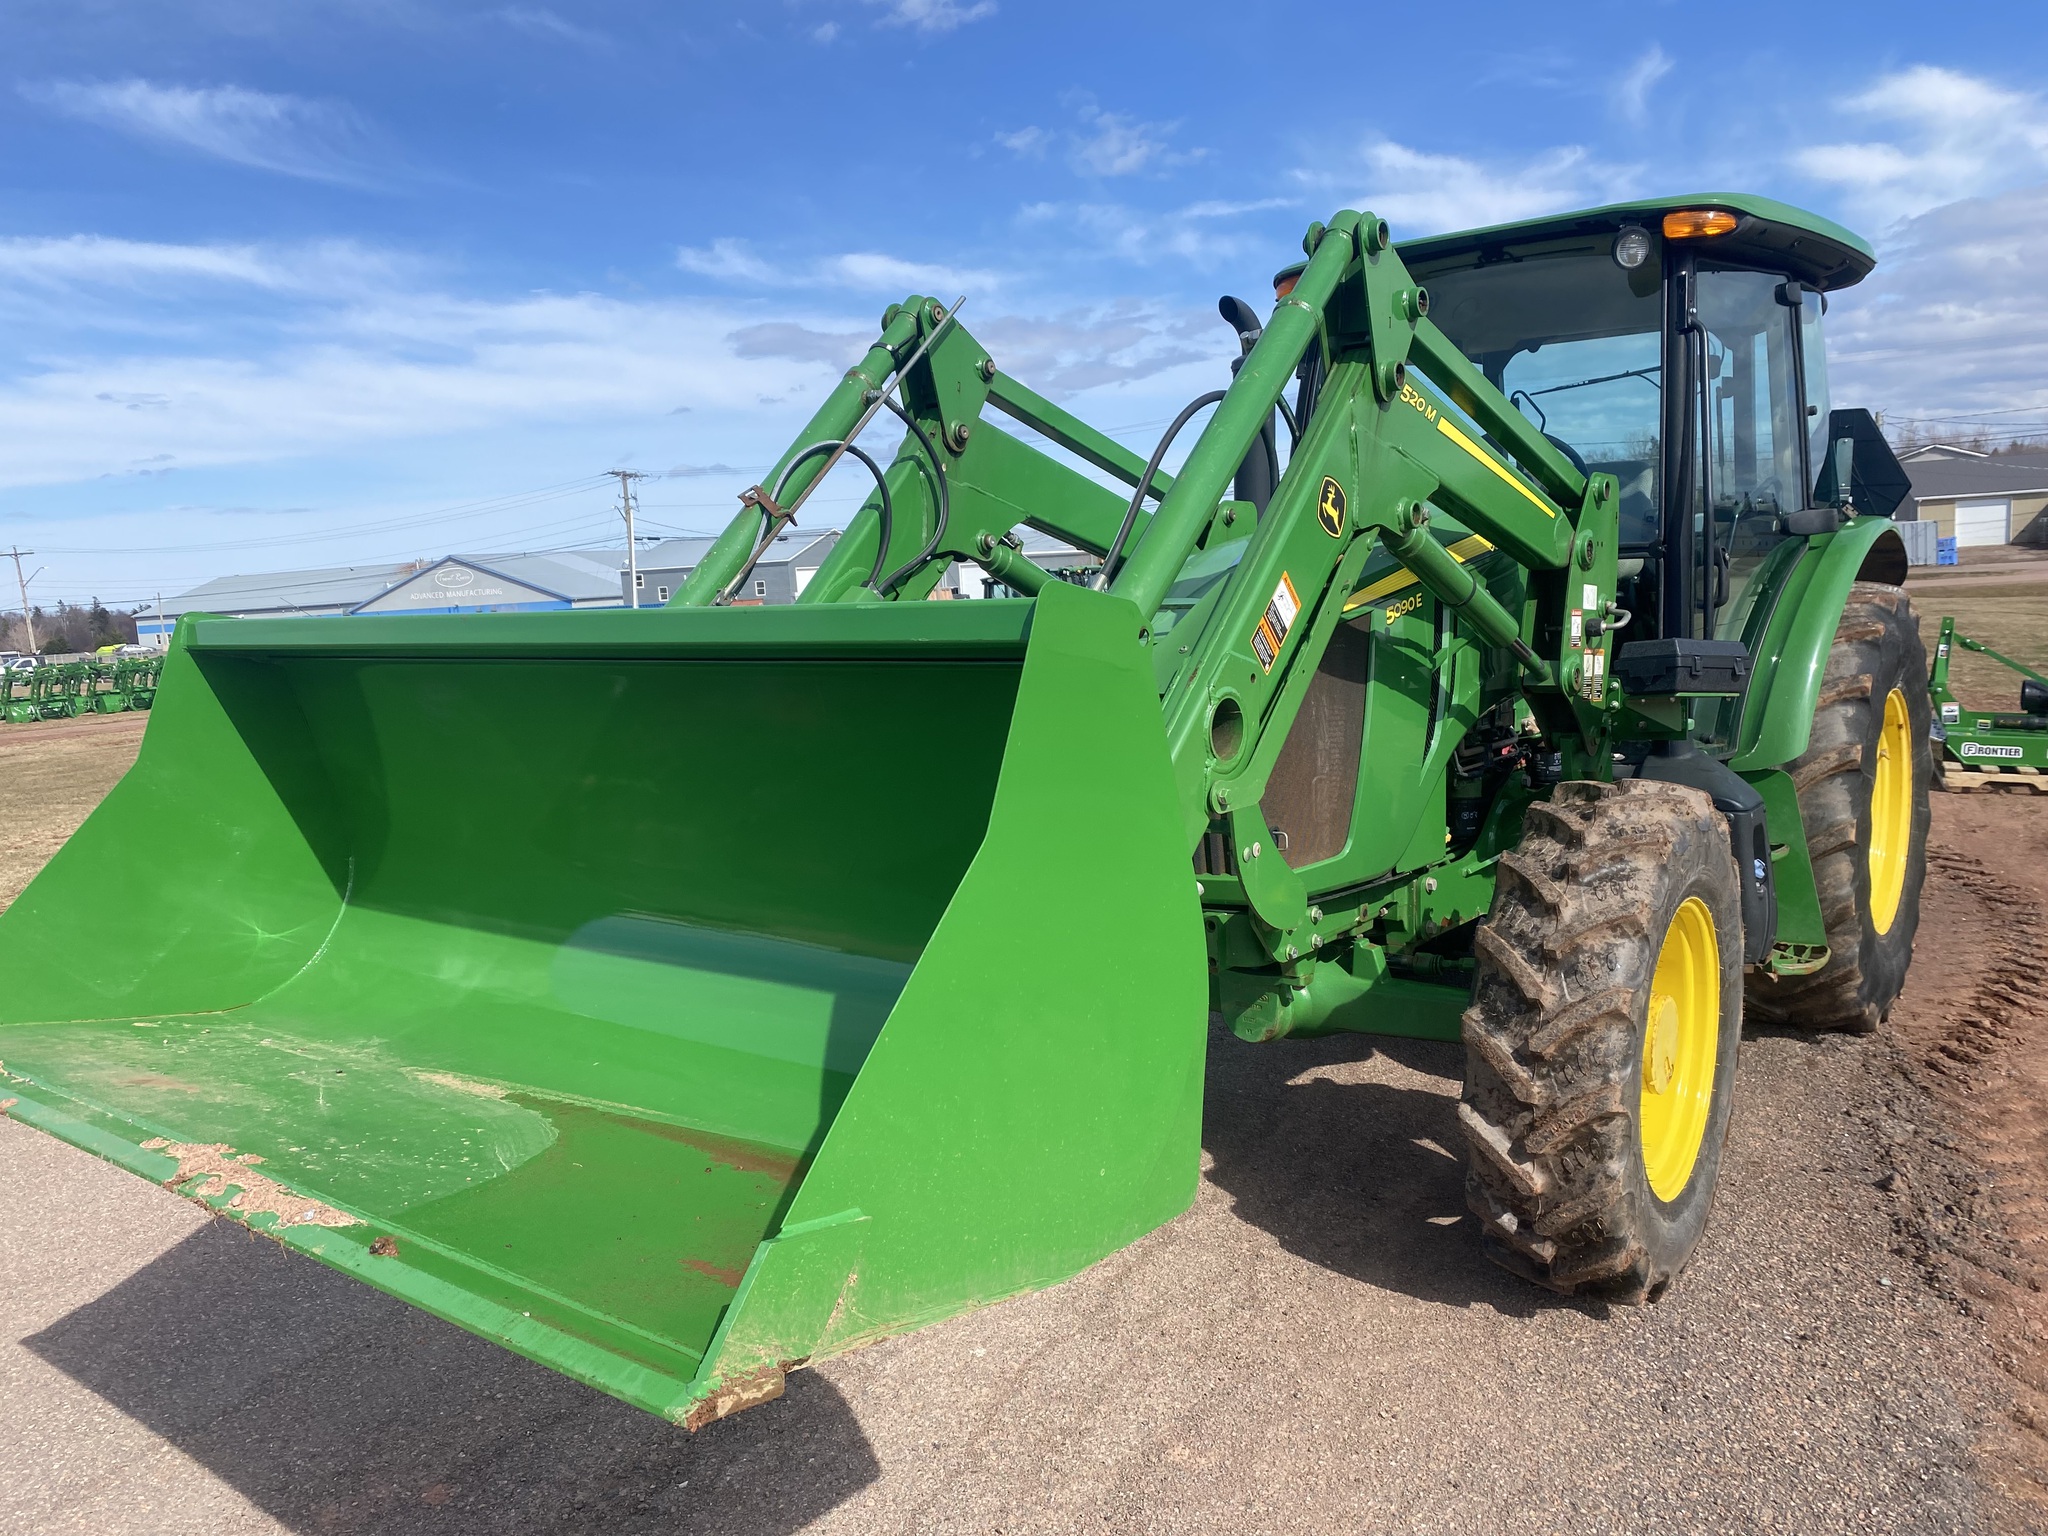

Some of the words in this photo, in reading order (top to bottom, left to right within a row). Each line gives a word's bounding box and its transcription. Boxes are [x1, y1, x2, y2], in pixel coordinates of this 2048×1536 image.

[1399, 383, 1426, 412] 520
[1424, 403, 1438, 424] M
[410, 591, 444, 600] ADVANCED
[446, 588, 502, 598] MANUFACTURING
[1386, 596, 1415, 626] 5090
[1416, 592, 1423, 608] E
[1963, 743, 2020, 756] FRONTIER
